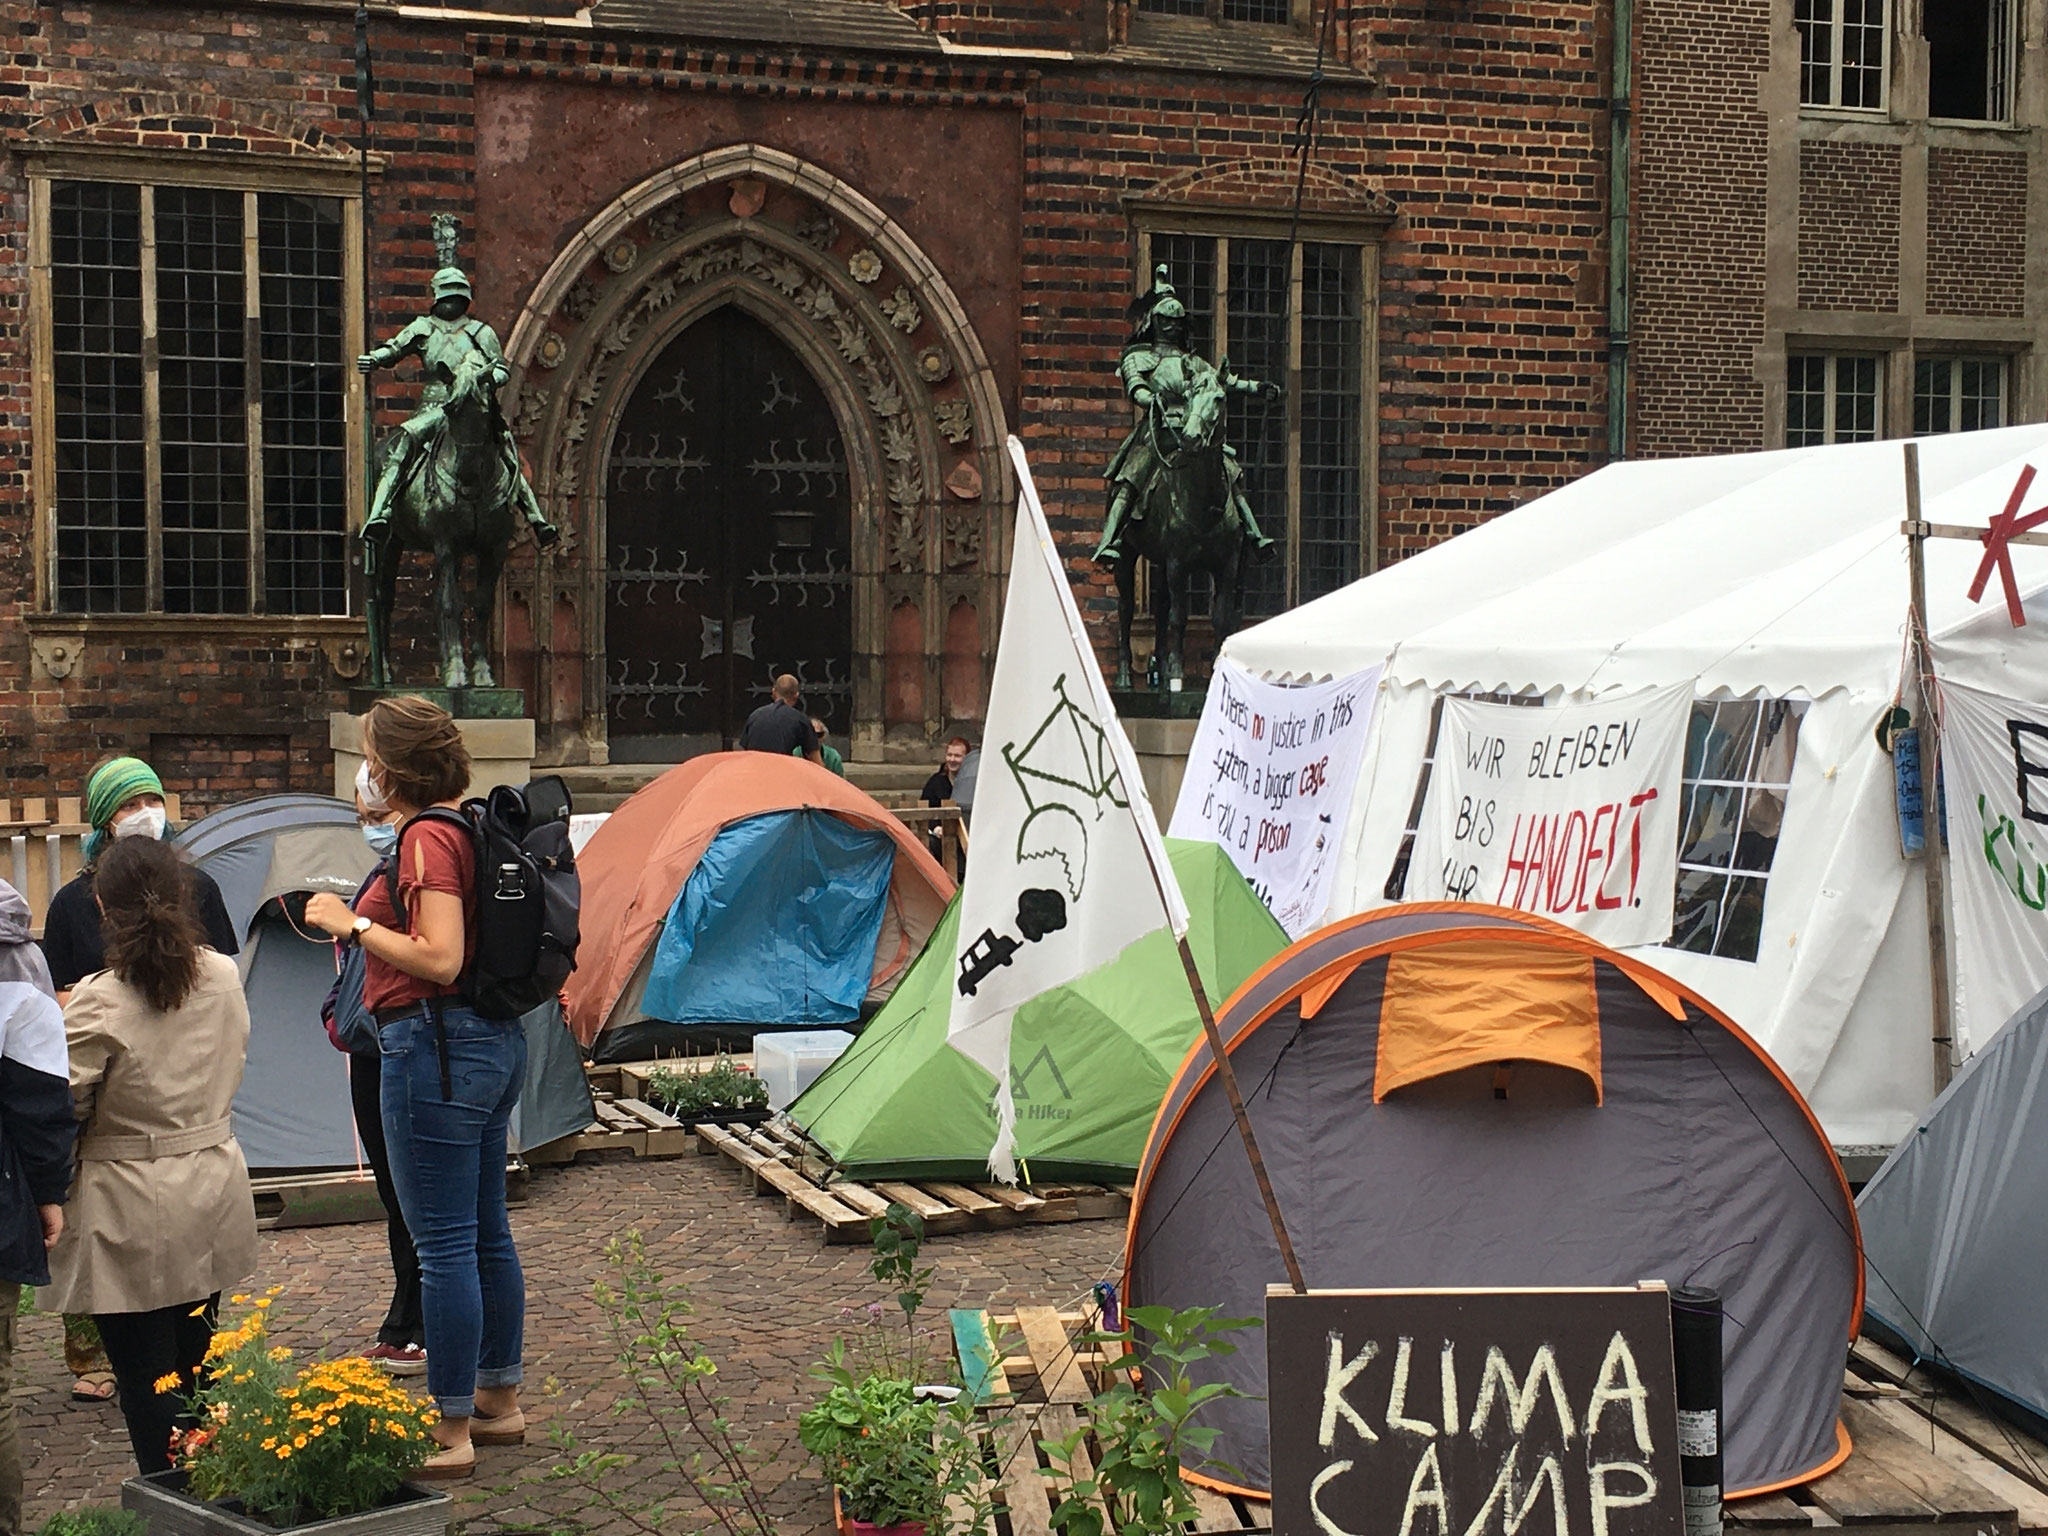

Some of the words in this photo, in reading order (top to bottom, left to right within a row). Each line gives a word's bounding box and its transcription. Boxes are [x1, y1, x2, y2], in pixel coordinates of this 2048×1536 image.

[1252, 713, 1265, 741] no
[1268, 711, 1306, 755] justice
[1310, 709, 1325, 744] in
[1329, 693, 1356, 735] this
[1467, 731, 1505, 779] WIR
[1527, 718, 1641, 779] BLEIBEN
[1253, 768, 1261, 794] a
[1264, 763, 1296, 810] bigger
[1202, 784, 1215, 819] is
[1239, 815, 1250, 850] a
[1254, 817, 1291, 863] prison
[1443, 857, 1478, 902] IHR
[1496, 787, 1658, 914] HANDELT.
[1455, 795, 1496, 848] BIS
[1028, 1104, 1072, 1120] Hiker
[1318, 1329, 1655, 1462] KLIMA
[1310, 1440, 1658, 1536] CAMP
